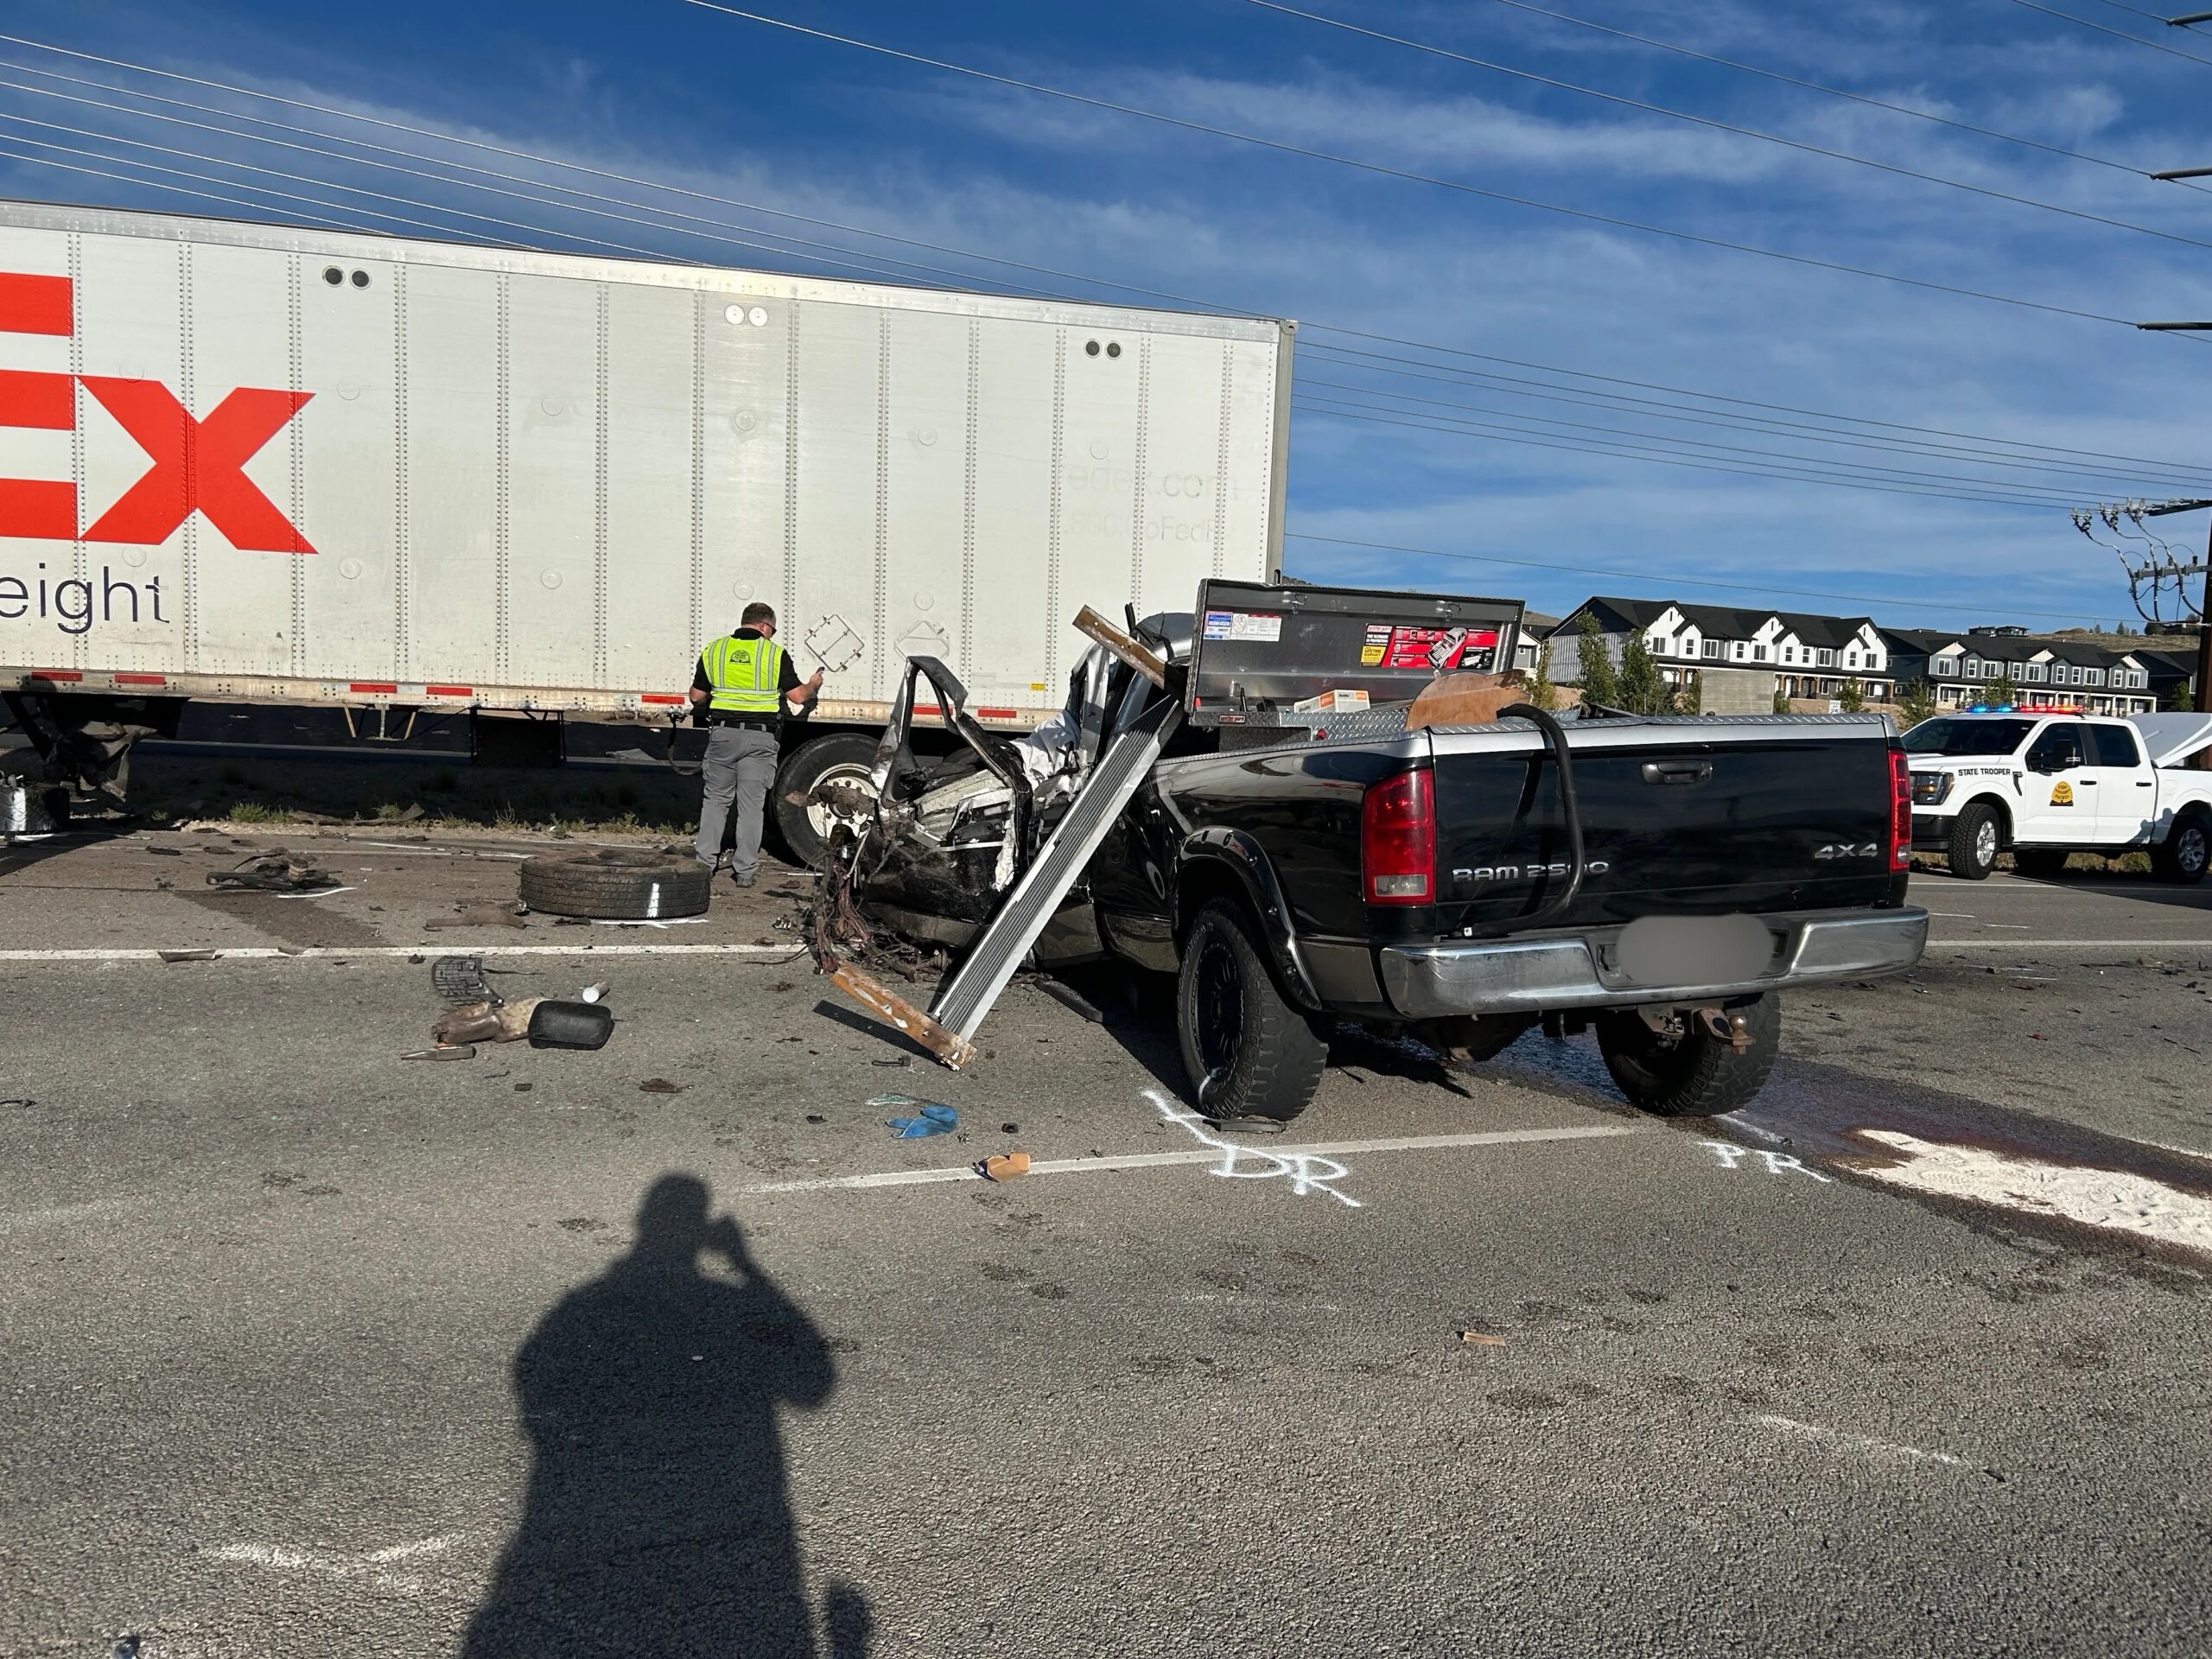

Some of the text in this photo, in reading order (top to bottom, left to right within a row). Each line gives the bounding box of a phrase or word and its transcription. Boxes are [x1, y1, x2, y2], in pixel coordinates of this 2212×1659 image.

[0, 563, 169, 634] eight
[1452, 861, 1610, 882] RAM 250
